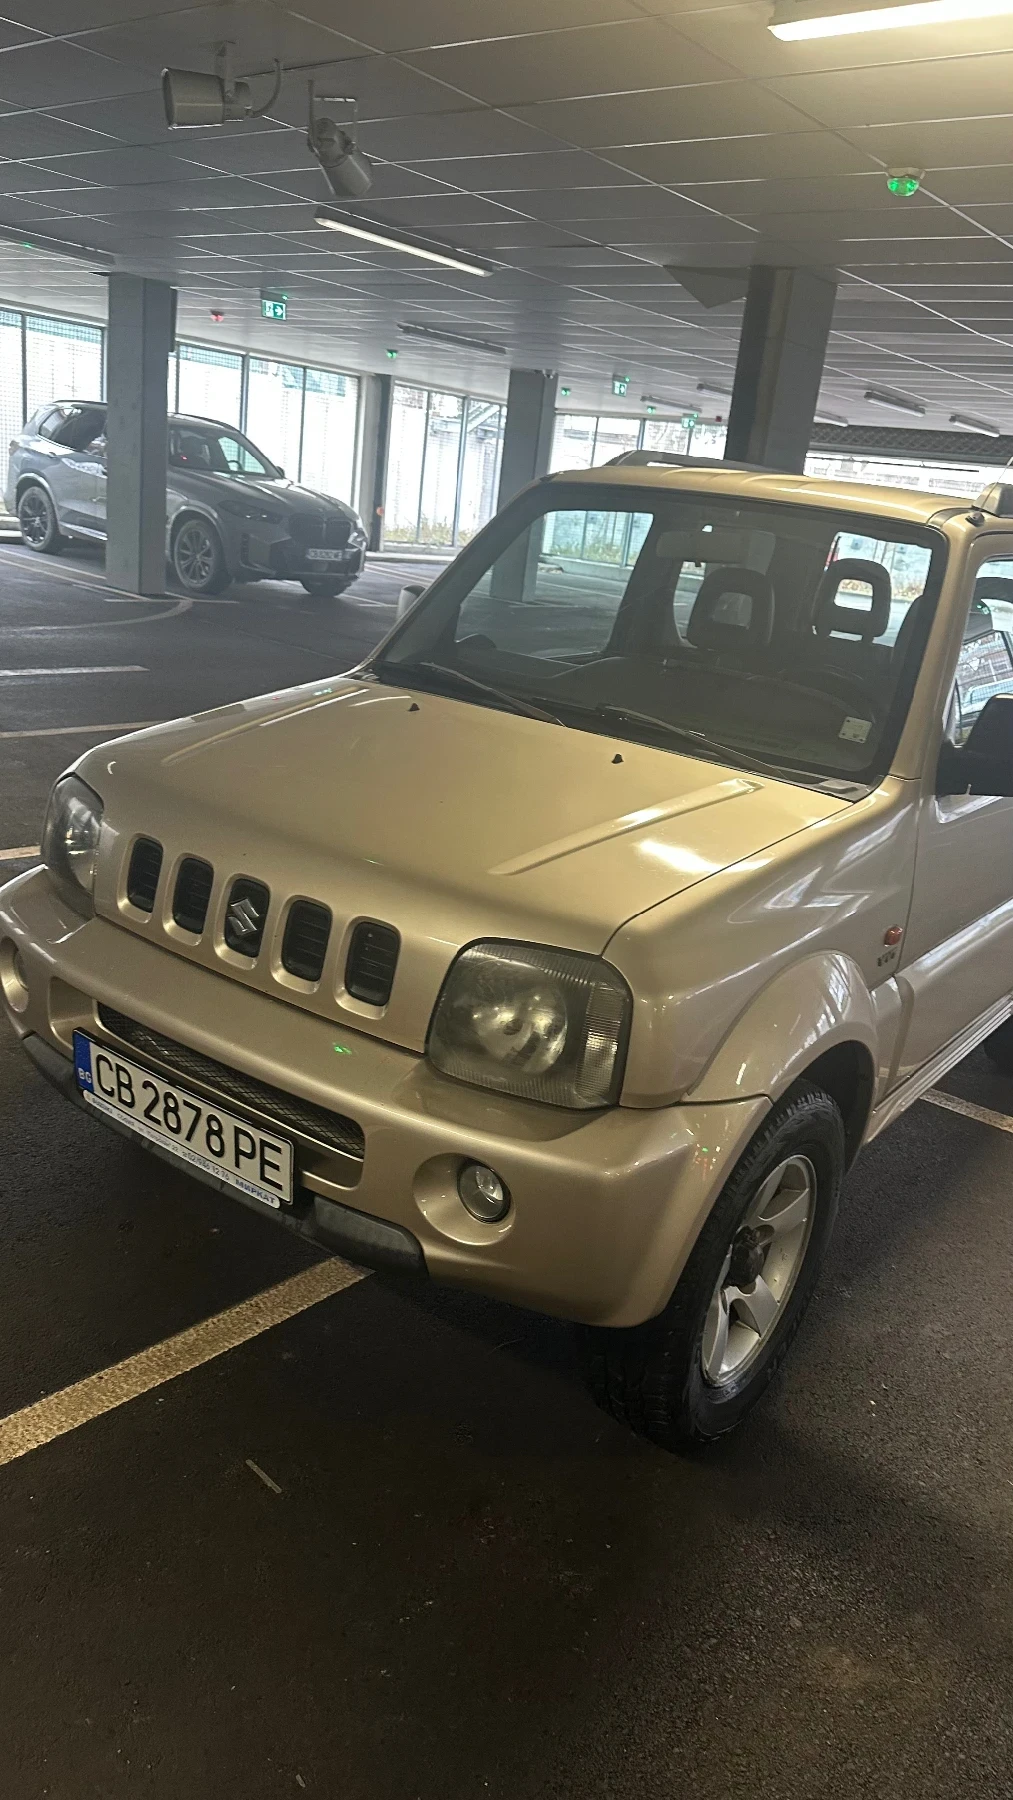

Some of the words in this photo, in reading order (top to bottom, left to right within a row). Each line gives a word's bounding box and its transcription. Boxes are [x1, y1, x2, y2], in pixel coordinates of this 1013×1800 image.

[77, 1067, 92, 1084] BG
[95, 1053, 135, 1109] CB
[142, 1080, 226, 1158] 2878
[233, 1125, 283, 1192] PE
[235, 1179, 276, 1204] МИРКАТ
